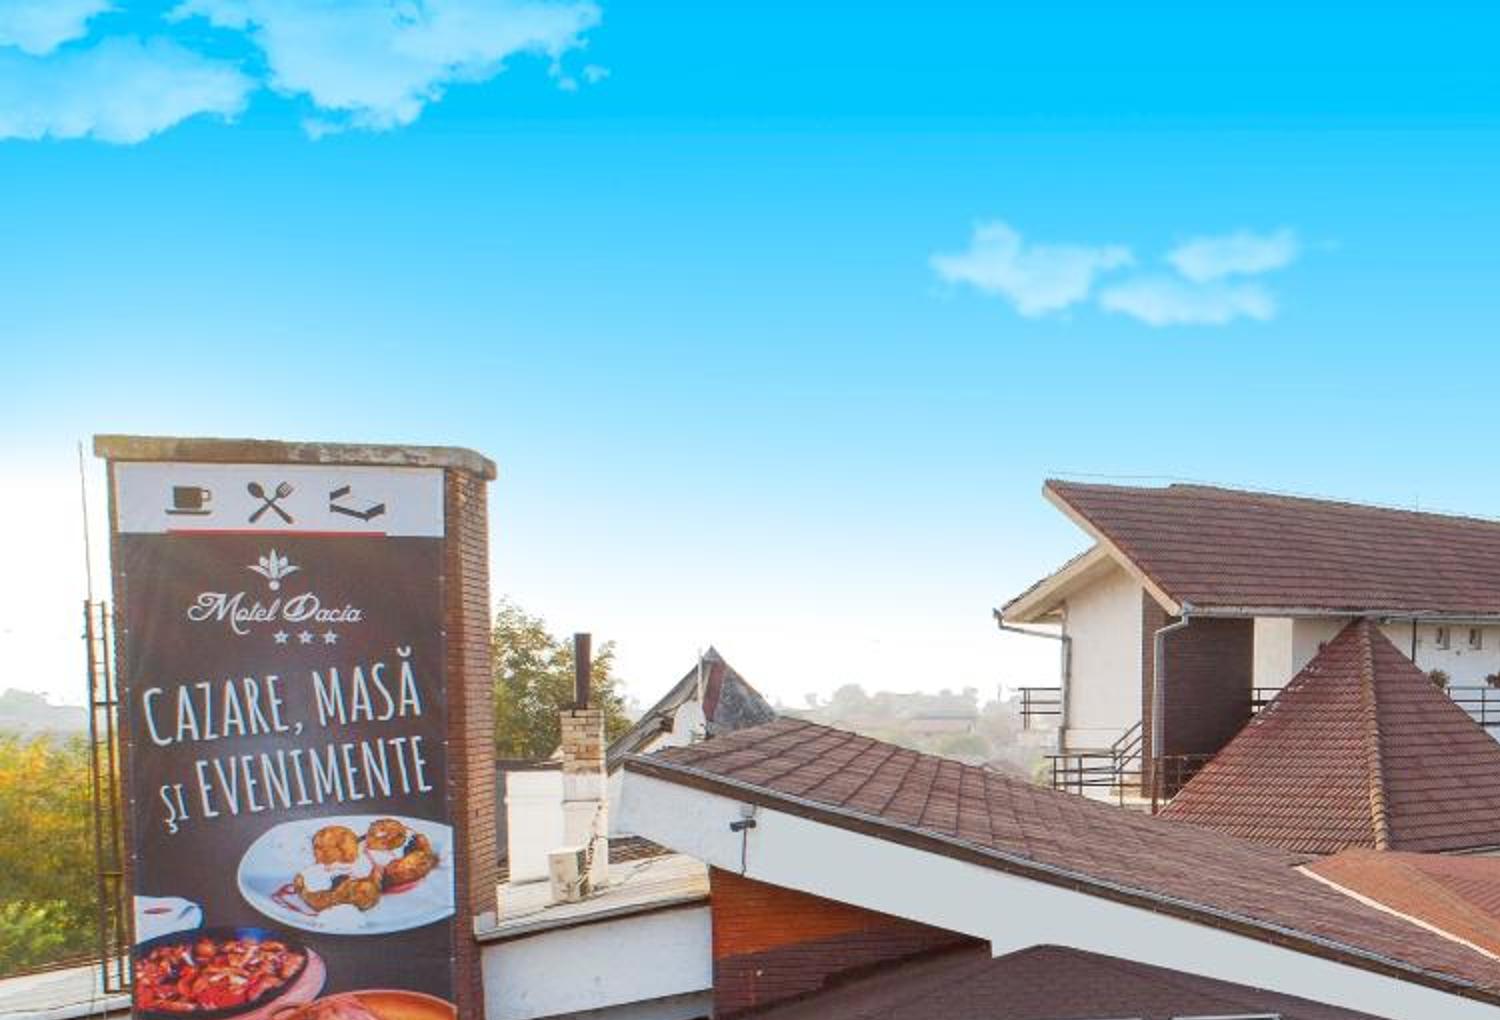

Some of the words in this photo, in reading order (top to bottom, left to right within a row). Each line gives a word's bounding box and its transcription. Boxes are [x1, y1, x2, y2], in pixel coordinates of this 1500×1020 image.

[187, 592, 278, 635] Motel
[283, 590, 364, 623] Dacia
[142, 675, 303, 747] CAZARE,
[312, 645, 422, 727] MASĂ
[196, 736, 433, 818] EVENIMENTE
